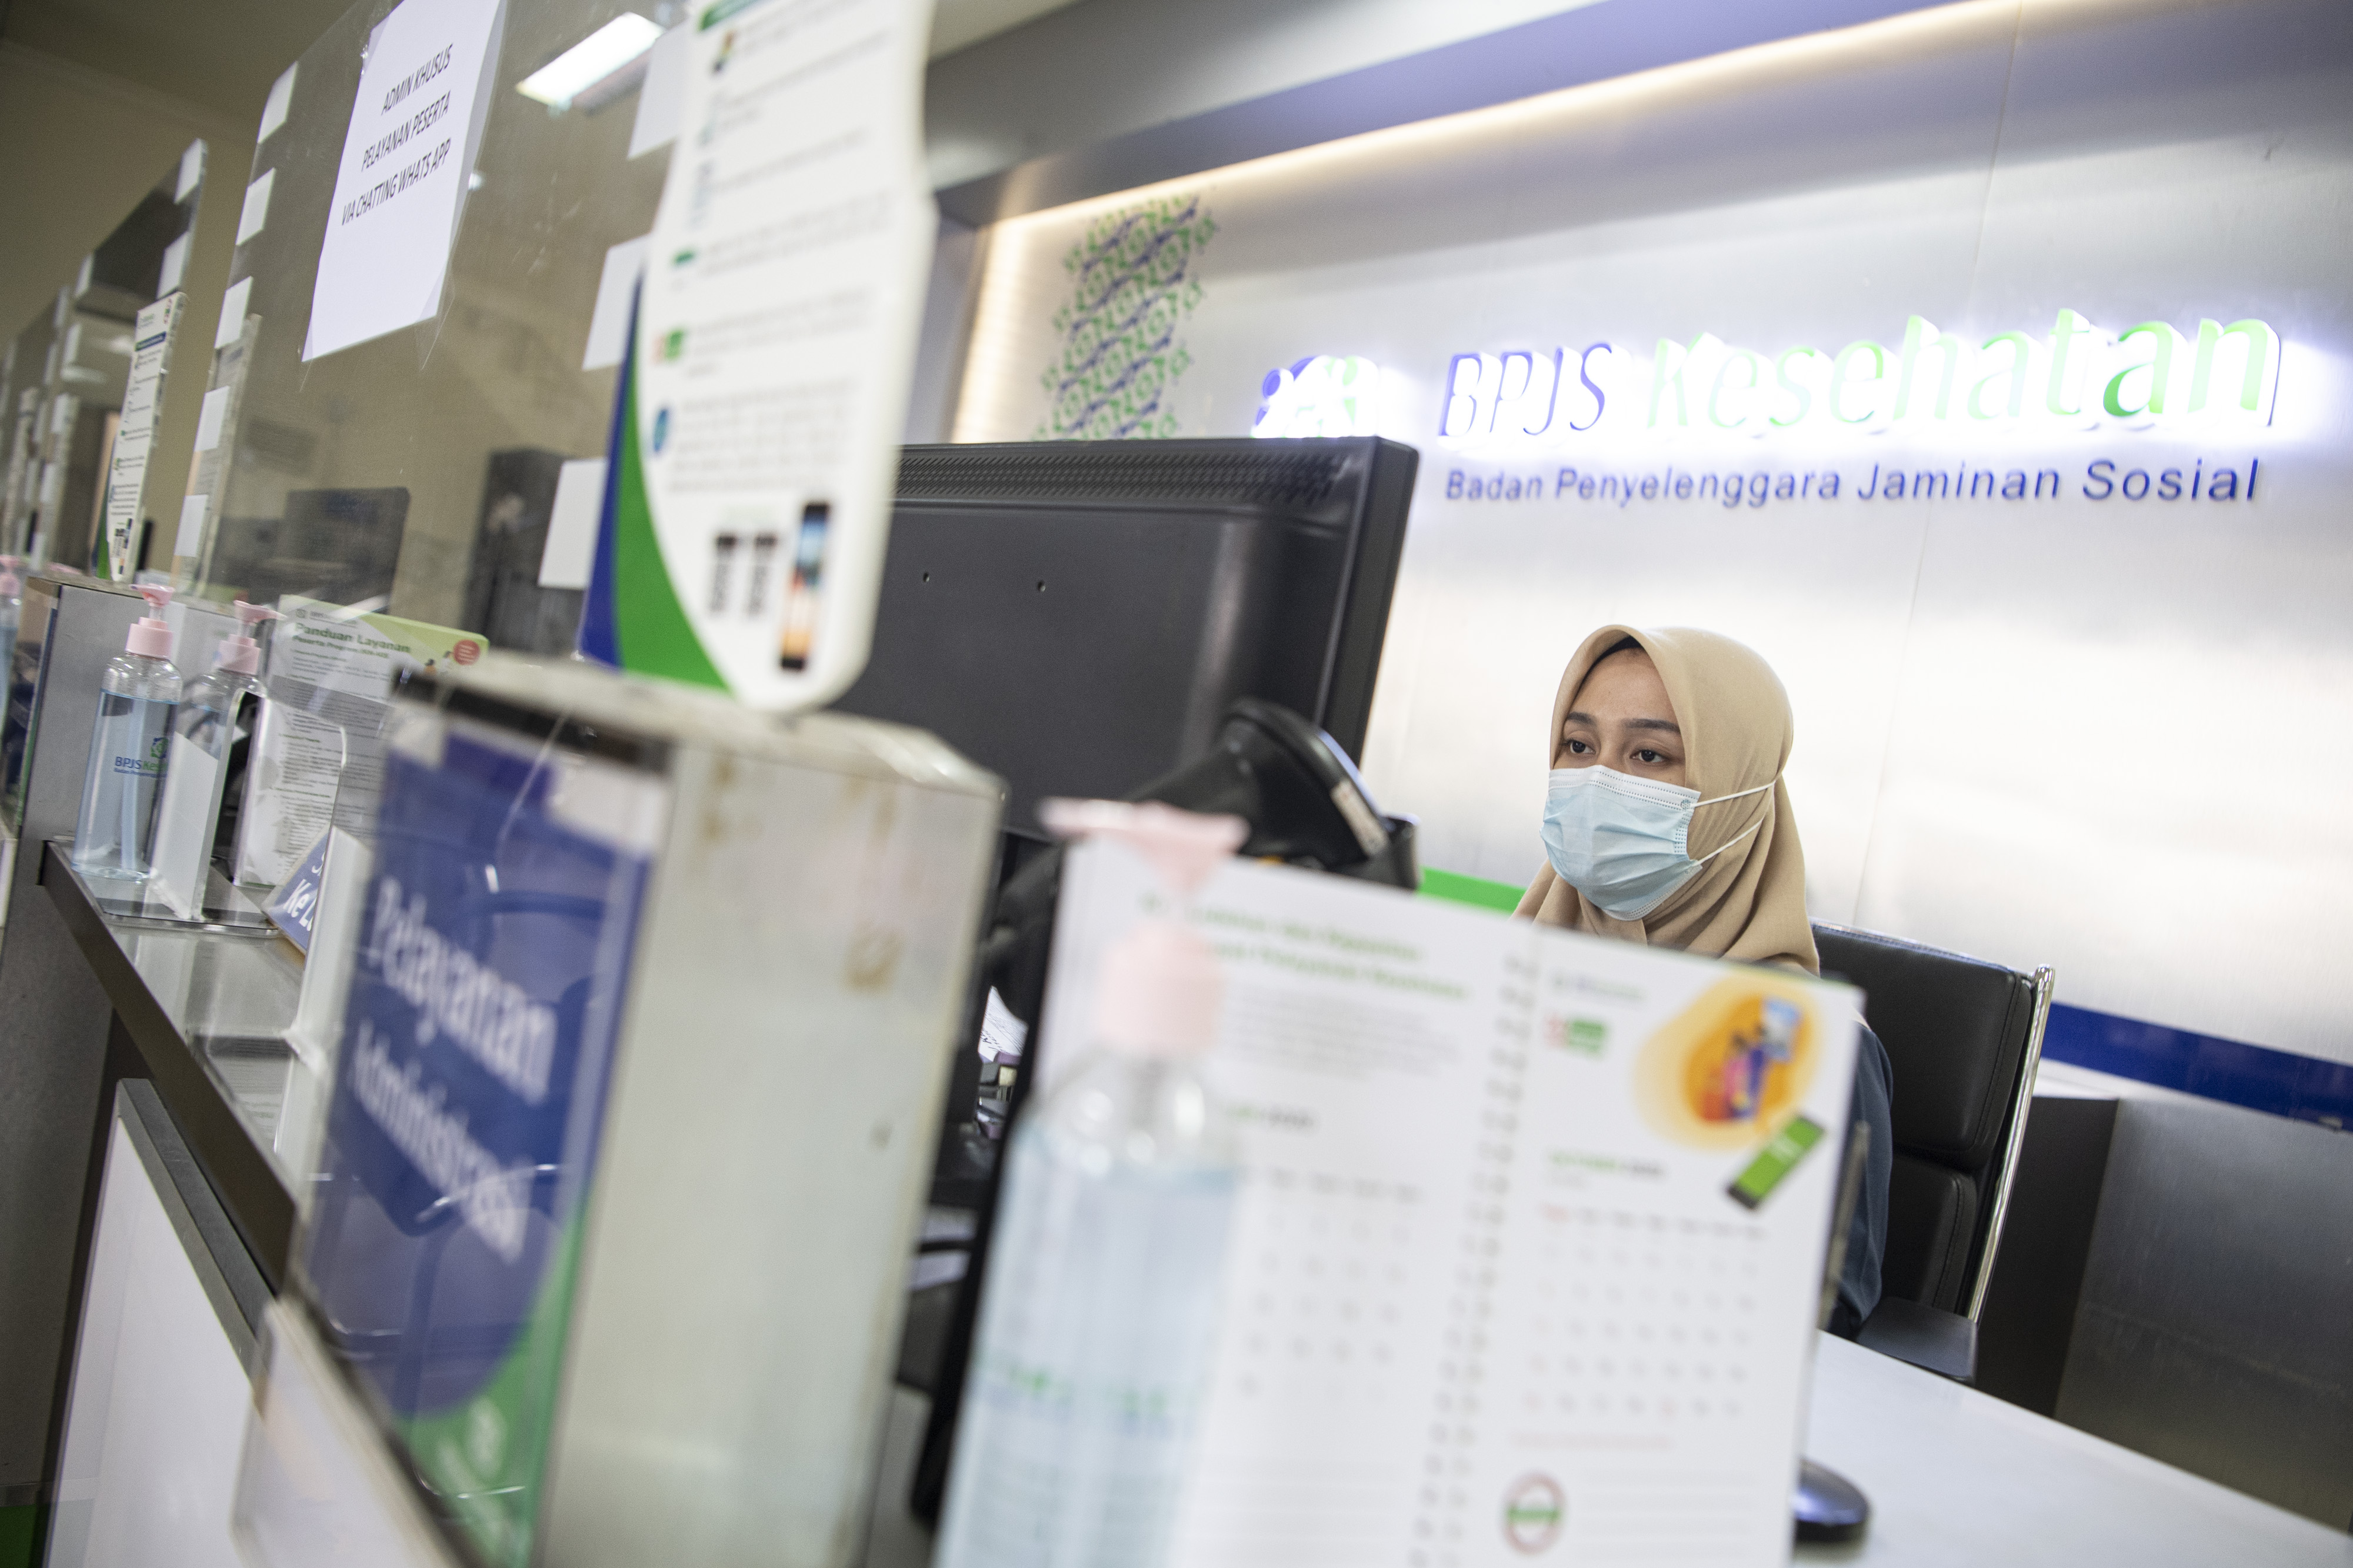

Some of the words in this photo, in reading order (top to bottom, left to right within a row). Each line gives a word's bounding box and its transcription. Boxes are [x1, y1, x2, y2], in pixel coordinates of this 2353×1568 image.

[381, 72, 414, 116] ADMIN
[412, 42, 453, 92] KHUSUS
[361, 118, 412, 172] PELAYANAN
[411, 89, 451, 140] PESERTA
[342, 199, 356, 226] VIA
[355, 173, 398, 218] CHATTING
[398, 151, 432, 194] WHATS
[429, 137, 452, 175] APP
[1437, 341, 1615, 436] BPJS
[1646, 307, 2275, 429] Kesehatan
[1445, 469, 1544, 502] Badan
[1554, 466, 1840, 508] Penyelenggara
[1857, 461, 2060, 501] Jaminan
[2082, 456, 2261, 502] Sosial
[295, 622, 353, 642] Panduan
[356, 634, 411, 653] Layanan
[115, 756, 142, 769] BPJS
